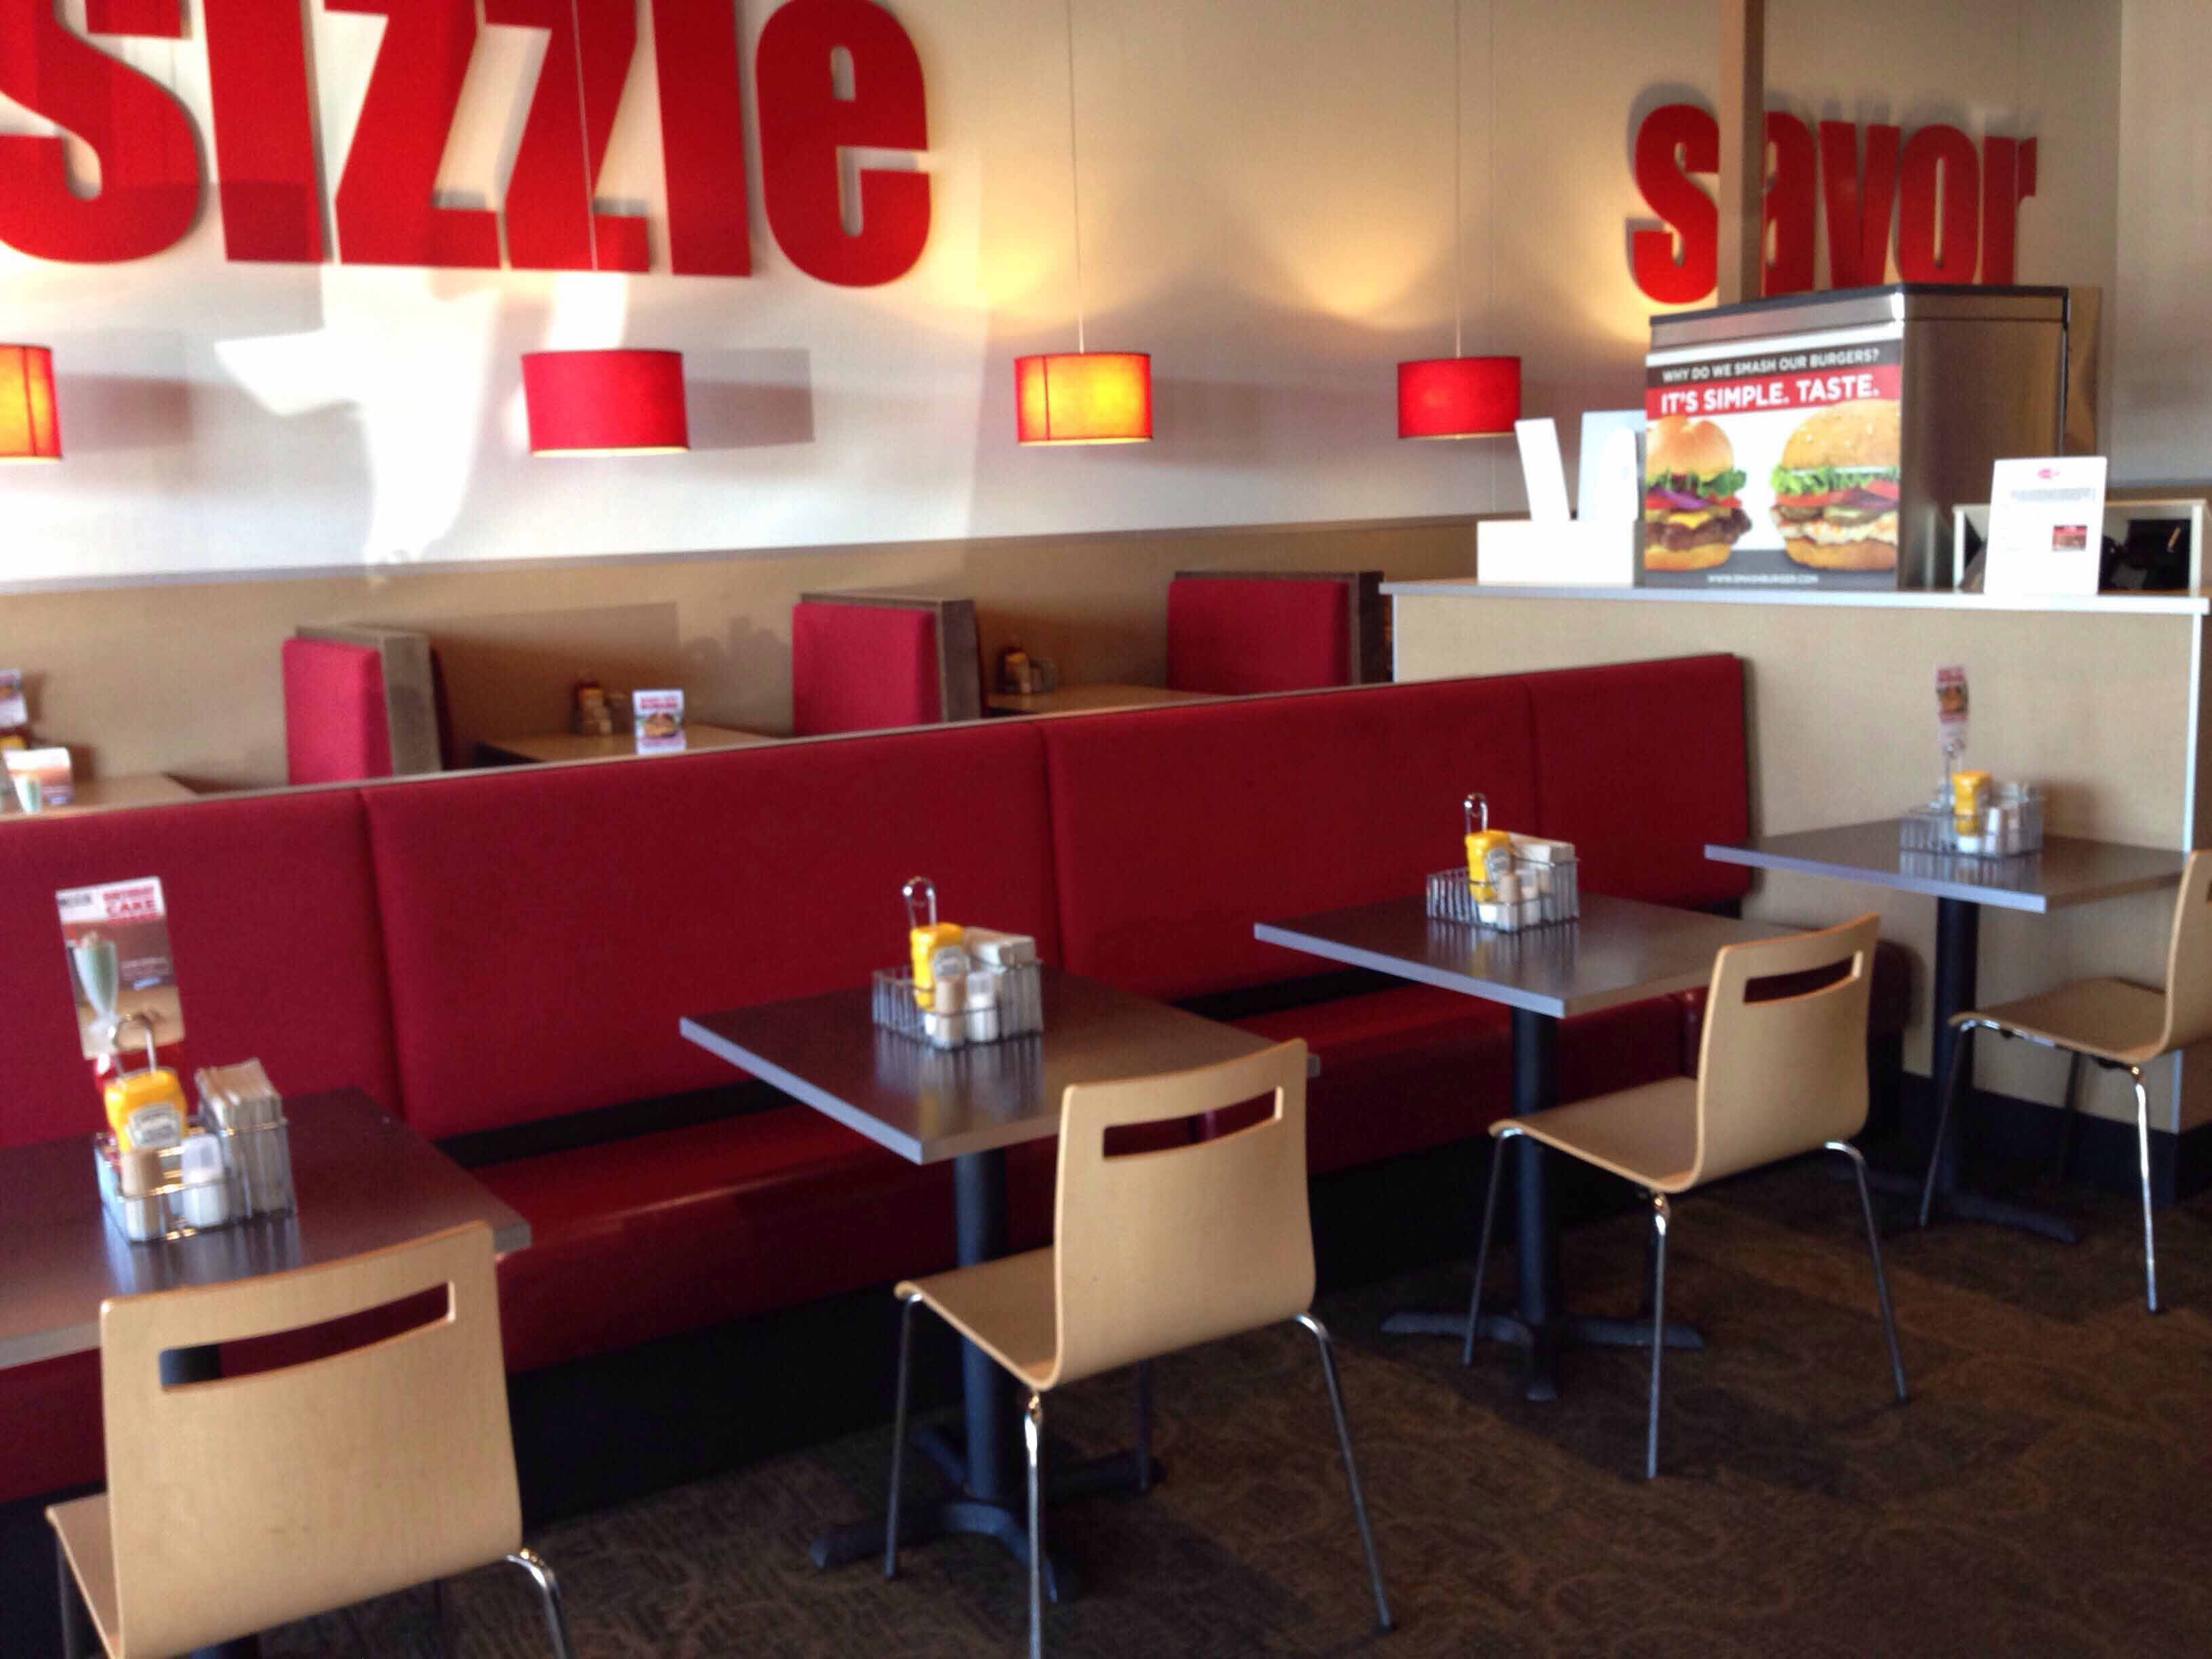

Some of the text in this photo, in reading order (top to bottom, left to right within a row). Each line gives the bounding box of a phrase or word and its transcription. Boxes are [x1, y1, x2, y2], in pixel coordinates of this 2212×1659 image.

[1662, 348, 1880, 383] WHY DO WE SMASH OUR BURGERS?
[1660, 373, 1880, 413] IT'S SIMPLE. TASTE.
